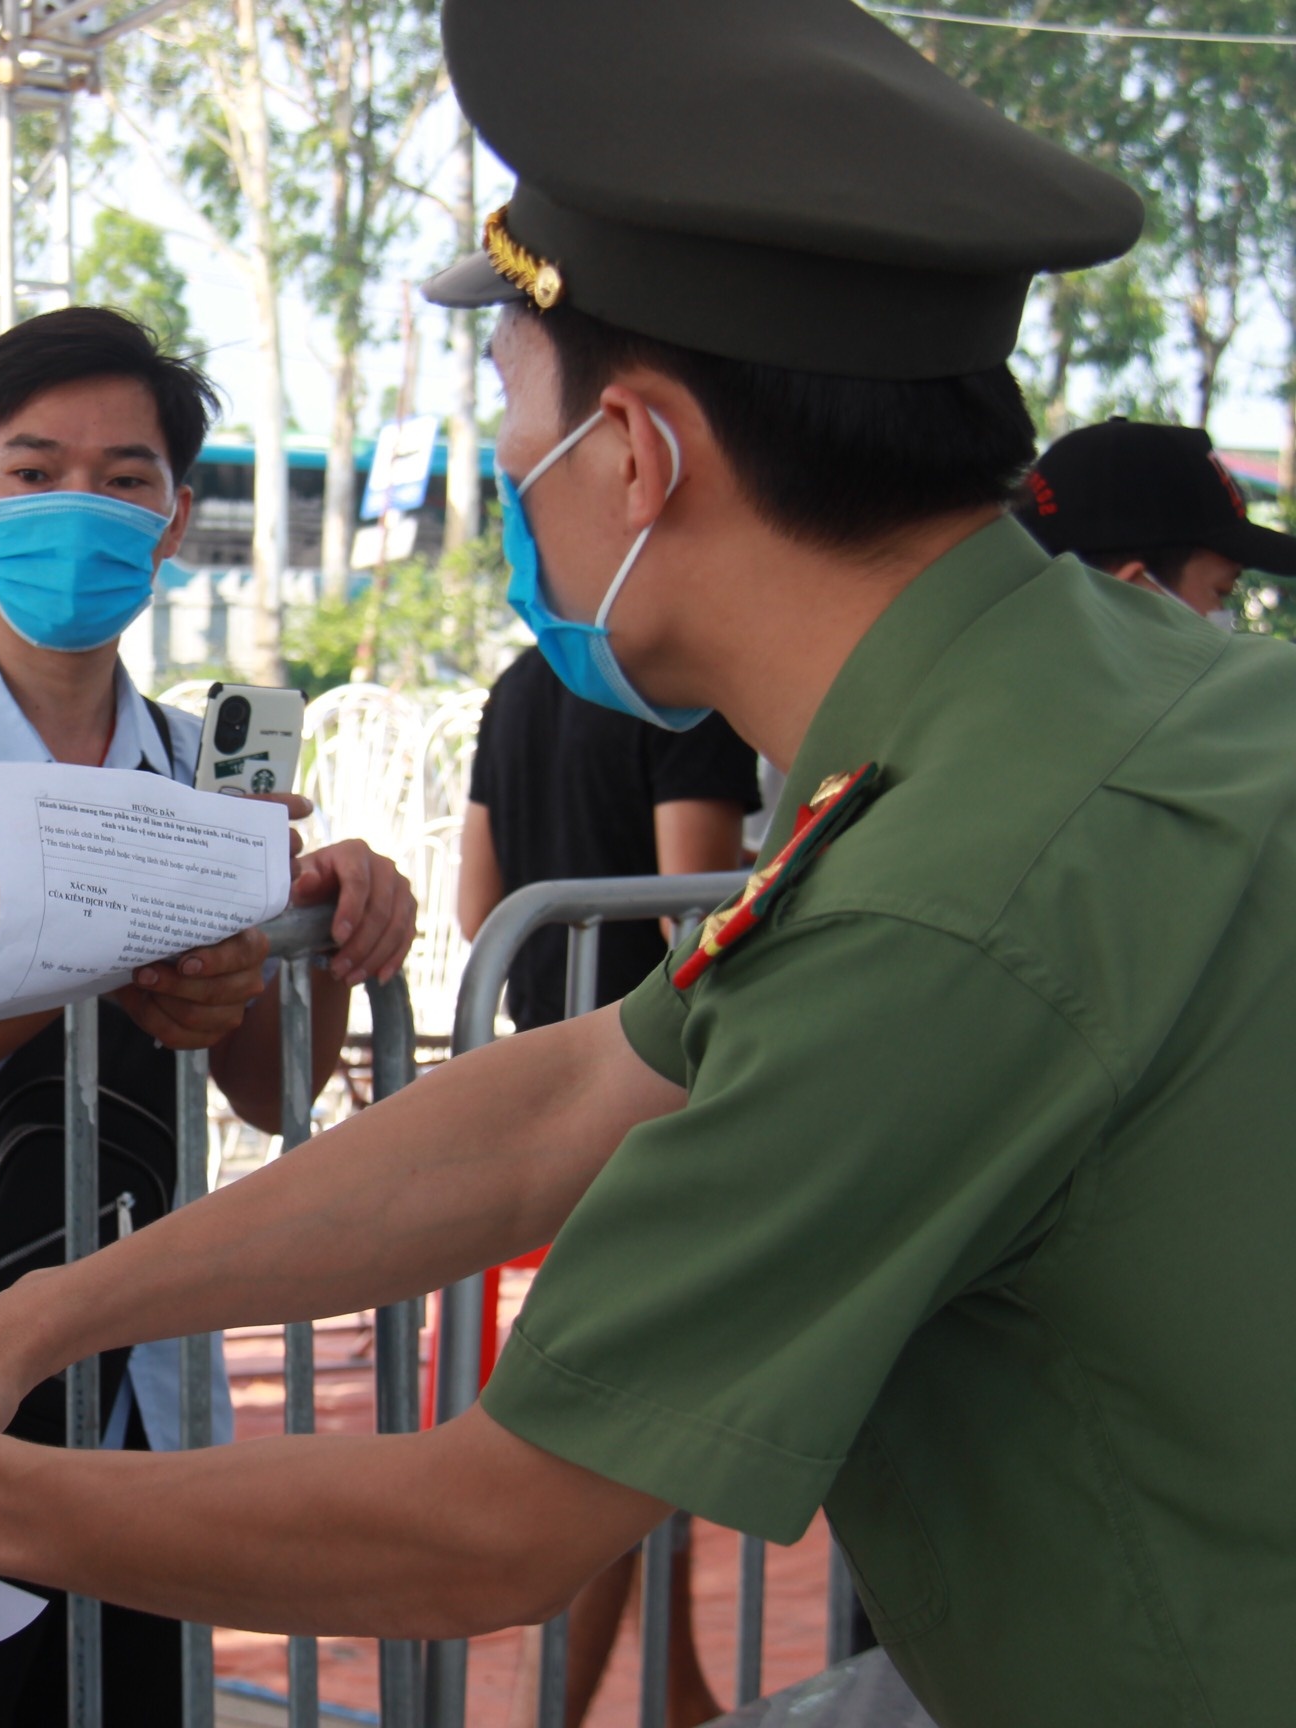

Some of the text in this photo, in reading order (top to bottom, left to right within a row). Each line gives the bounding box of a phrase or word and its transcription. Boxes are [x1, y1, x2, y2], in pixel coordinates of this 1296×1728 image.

[70, 880, 108, 896] XÁC NHẬN
[48, 889, 64, 900] CỦA
[86, 897, 104, 908] DỊCH
[104, 900, 122, 911] VIÊN
[122, 904, 128, 912] Y
